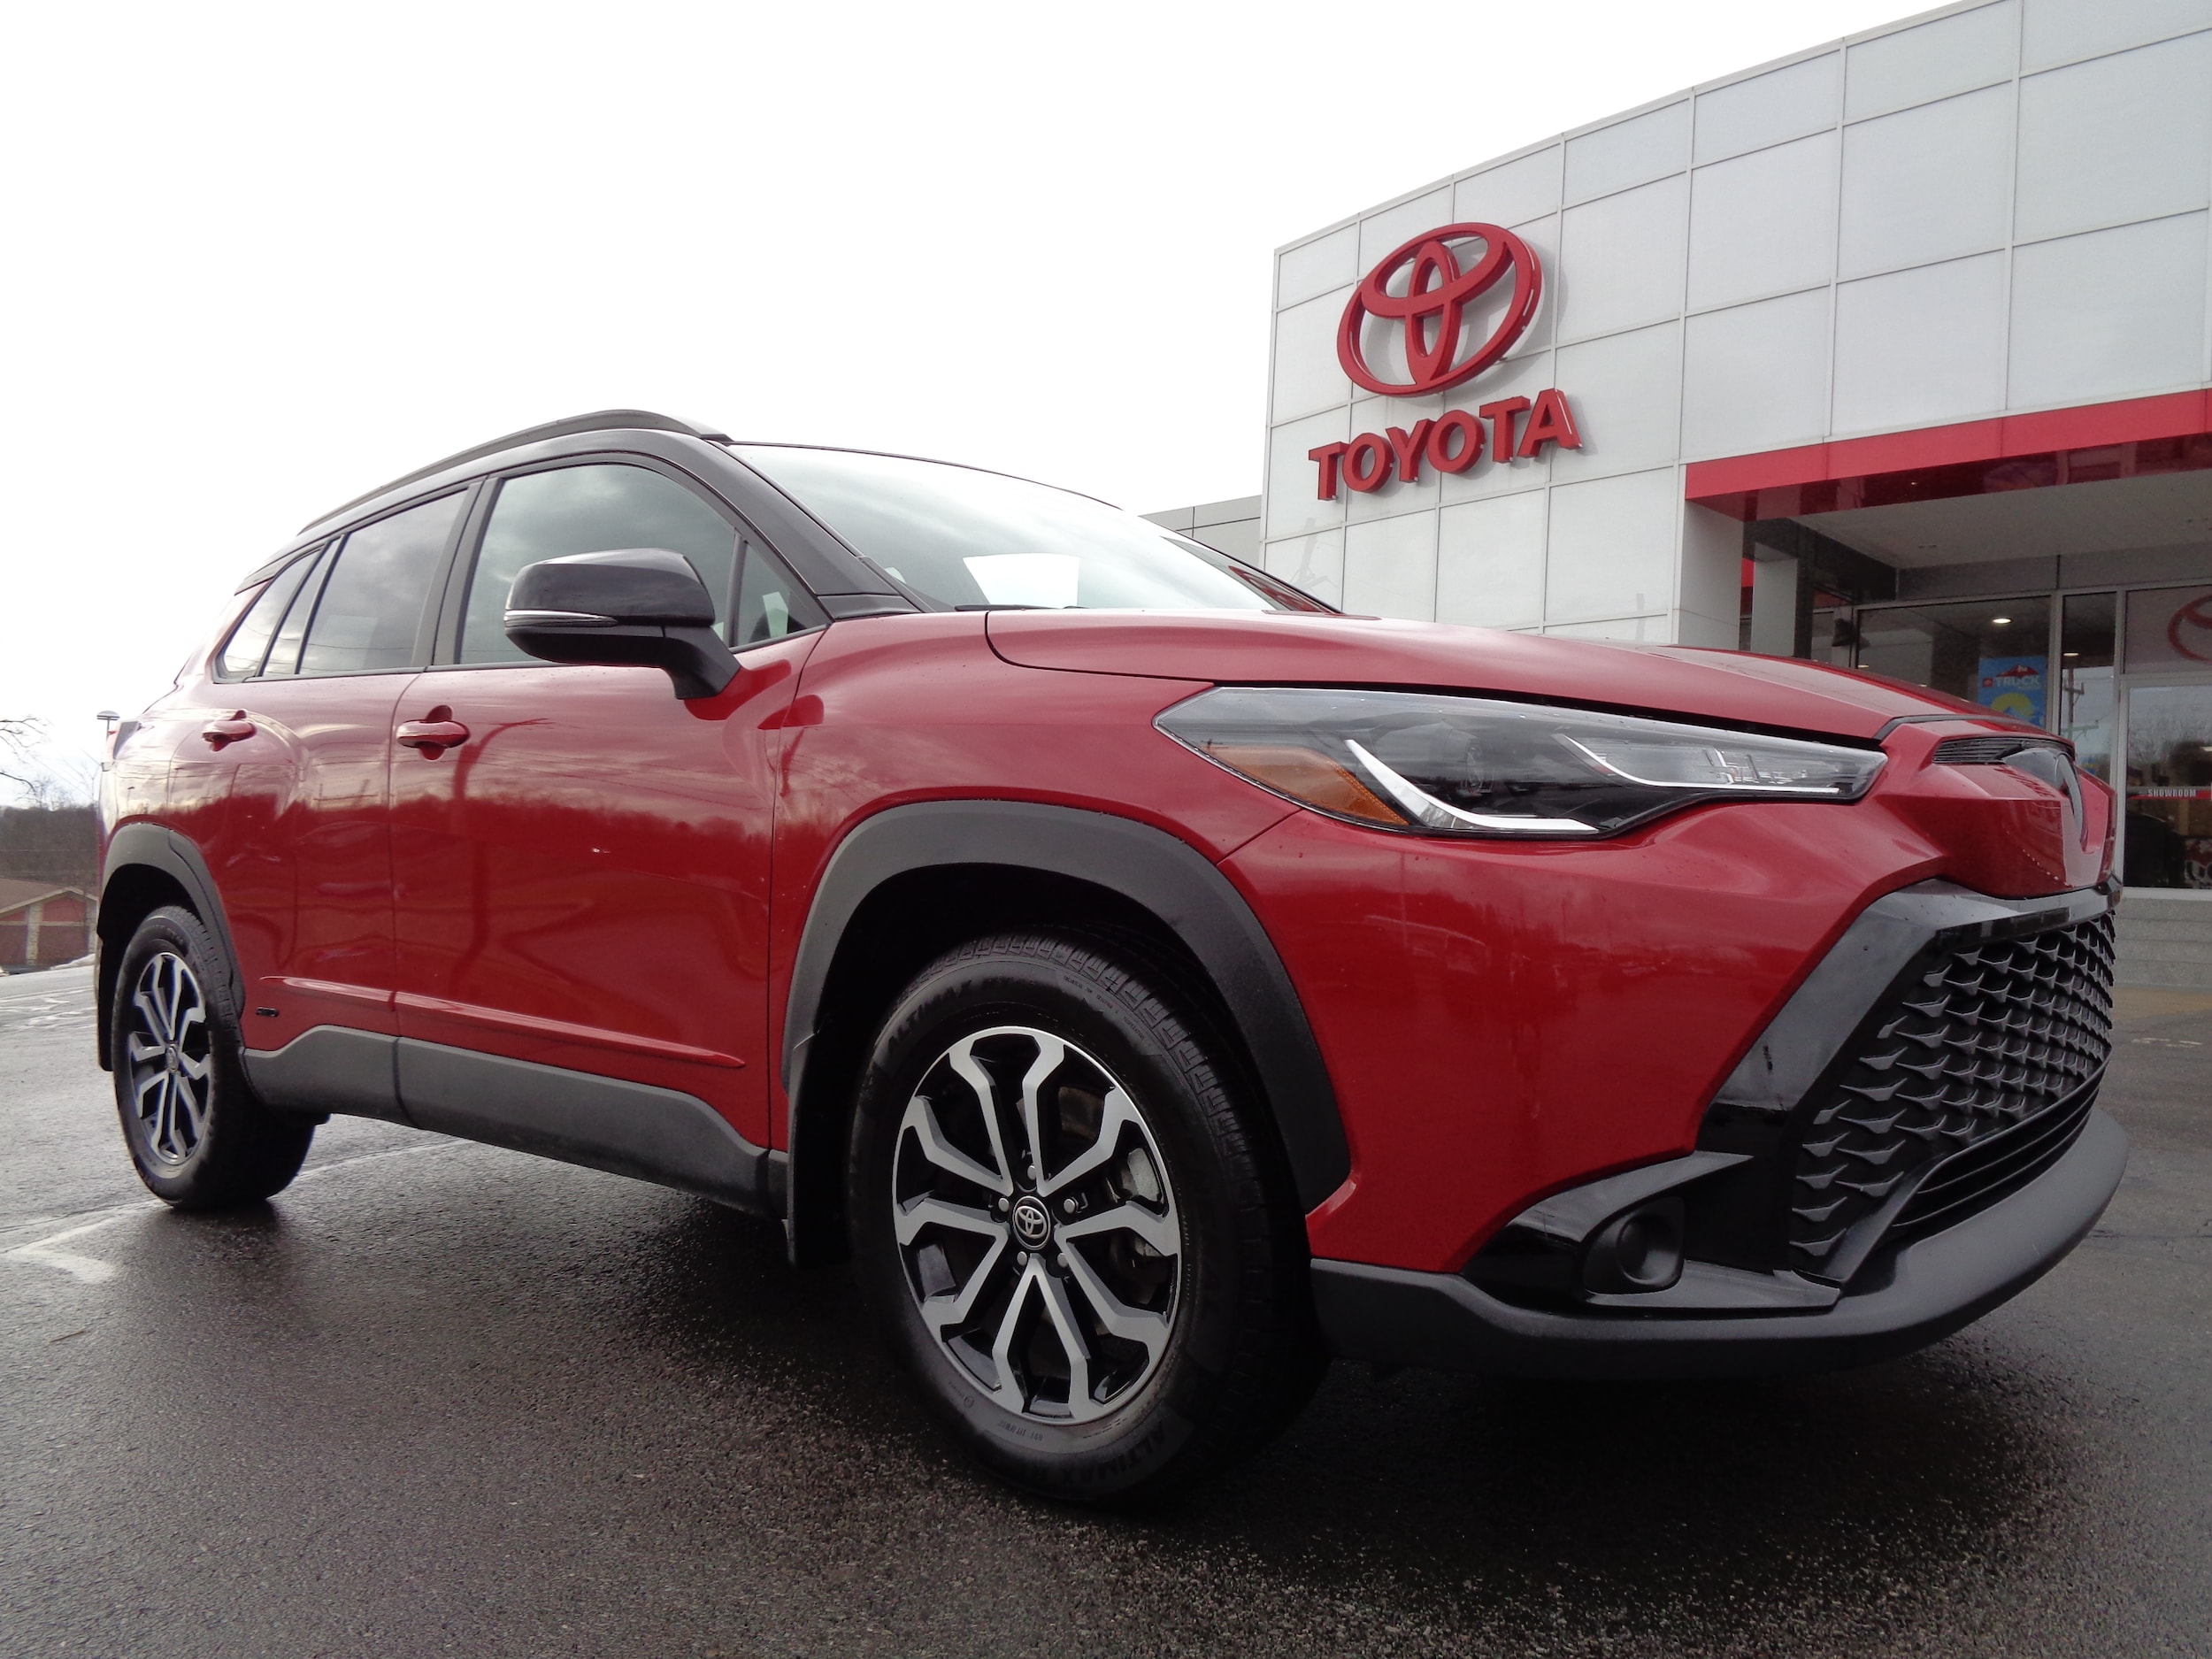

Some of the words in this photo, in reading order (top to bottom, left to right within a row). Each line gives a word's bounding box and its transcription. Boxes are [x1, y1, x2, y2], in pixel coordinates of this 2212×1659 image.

[1308, 388, 1582, 501] TOYOTA
[1995, 674, 2039, 687] TRUCK
[2147, 788, 2197, 797] SHOWROOM
